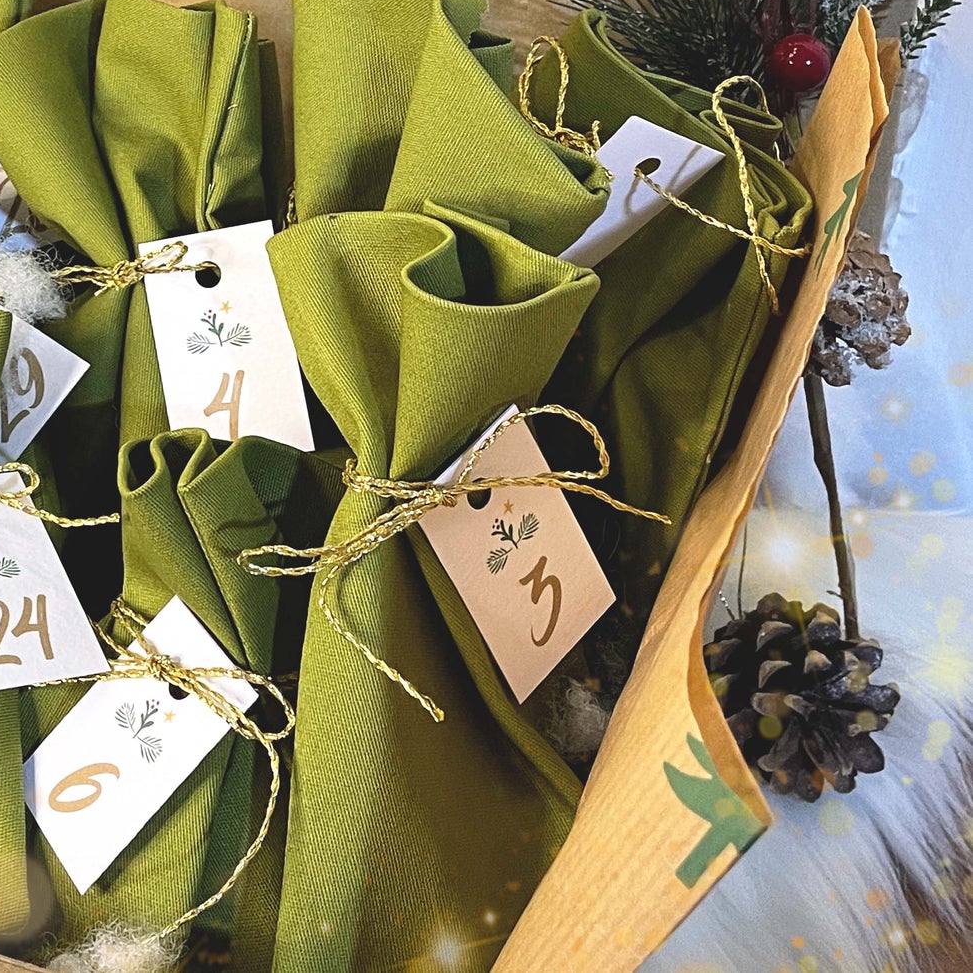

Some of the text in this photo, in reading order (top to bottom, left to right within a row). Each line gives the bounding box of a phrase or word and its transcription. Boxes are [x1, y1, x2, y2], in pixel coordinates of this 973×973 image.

[203, 370, 245, 440] 4
[519, 555, 562, 647] 3
[48, 762, 120, 813] 6
